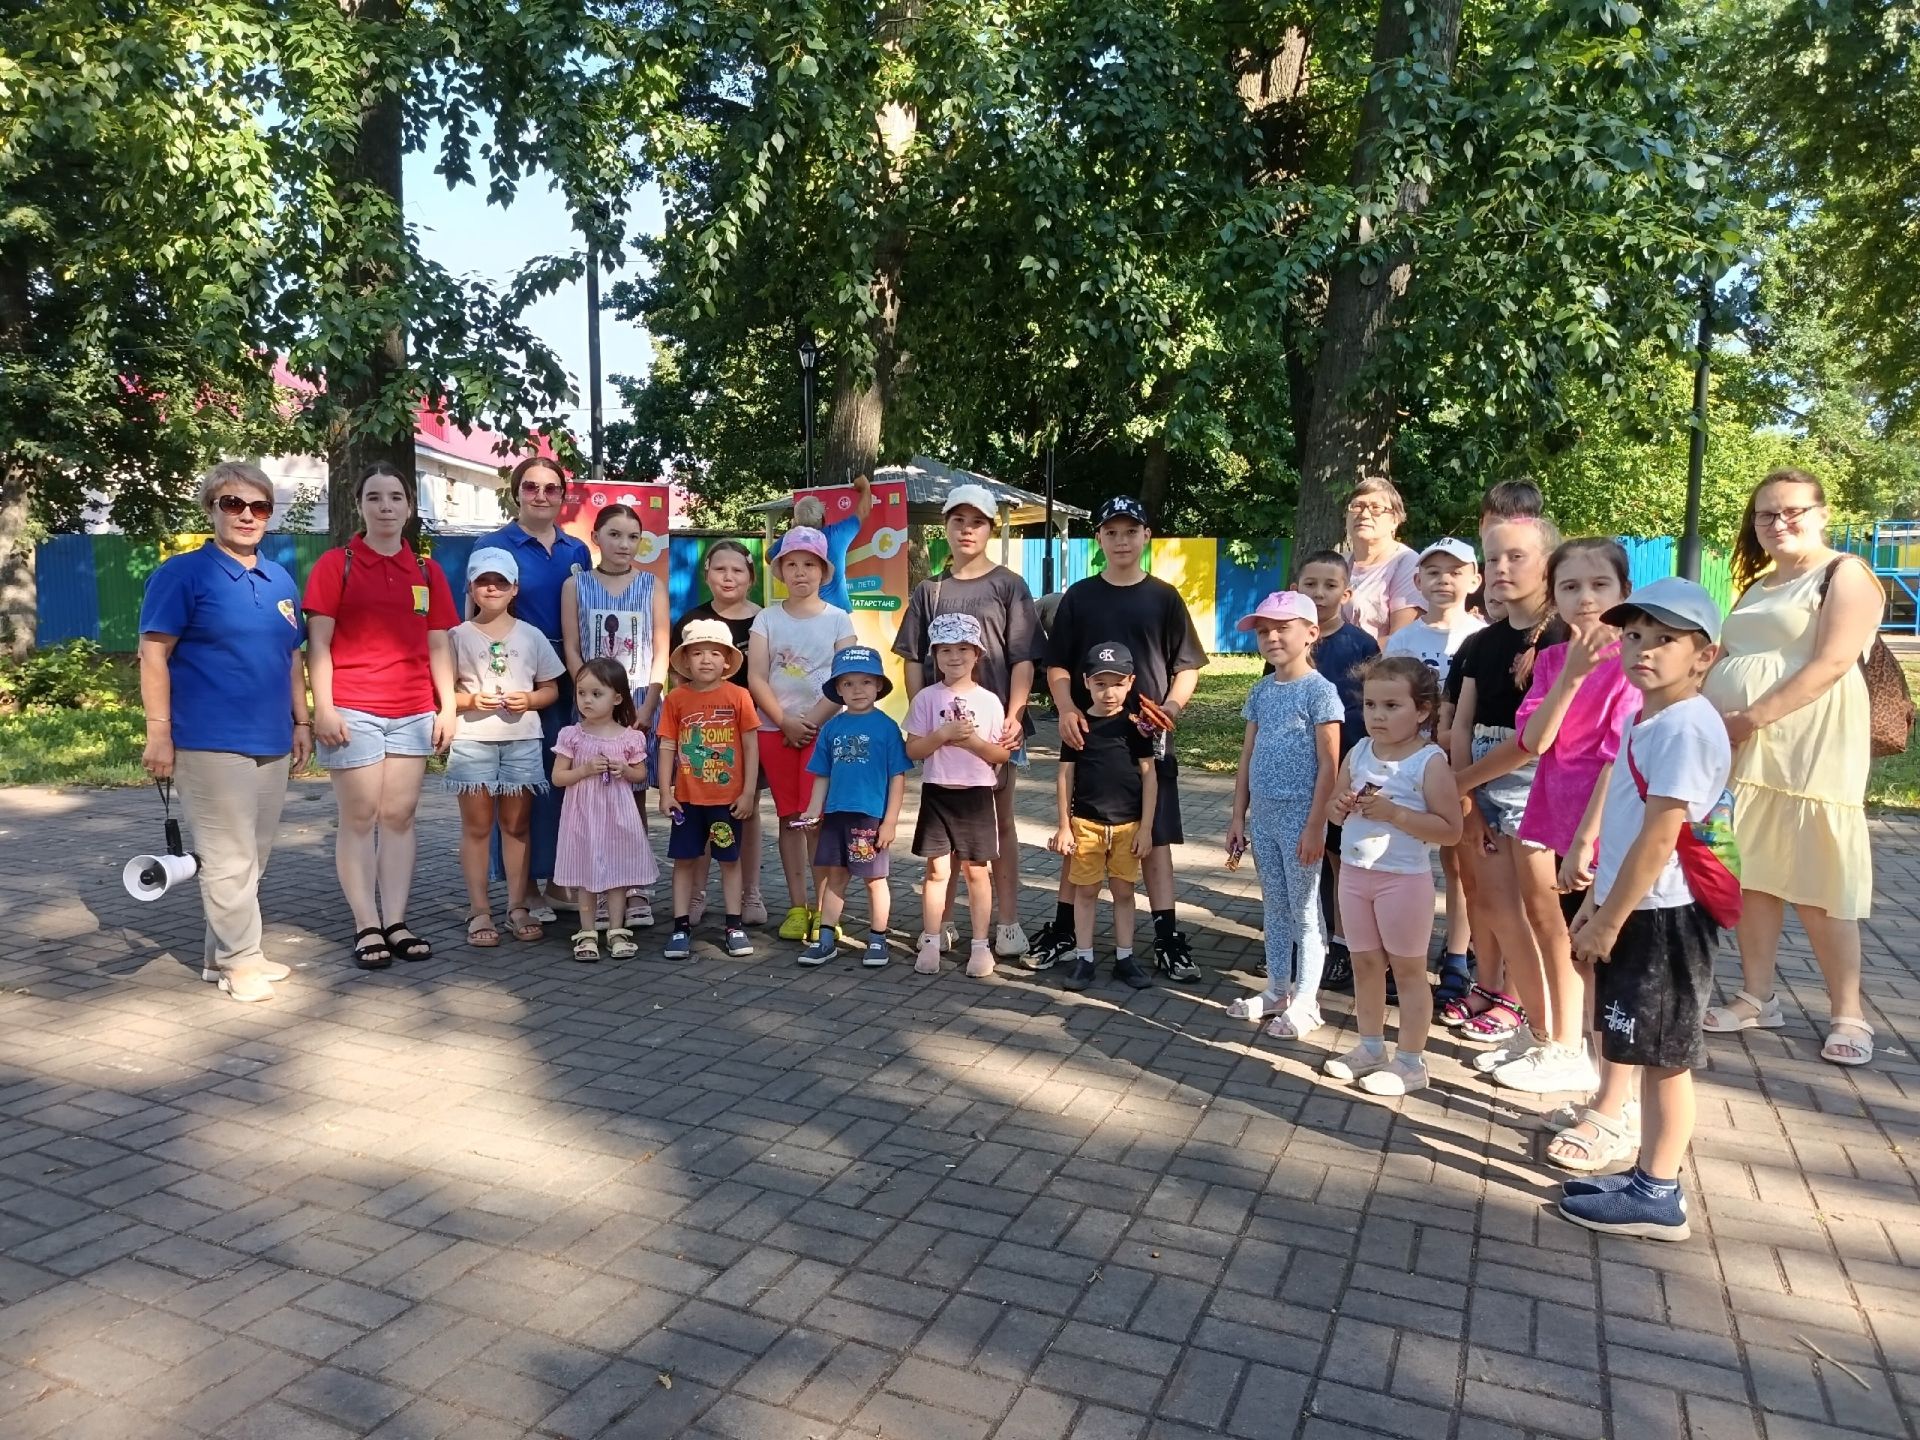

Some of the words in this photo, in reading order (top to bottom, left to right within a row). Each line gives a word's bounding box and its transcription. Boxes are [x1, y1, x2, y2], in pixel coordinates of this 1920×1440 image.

[1113, 497, 1128, 511] LA
[851, 599, 896, 608] ТАТАРСТАНЕ
[680, 727, 734, 743] AWSOME
